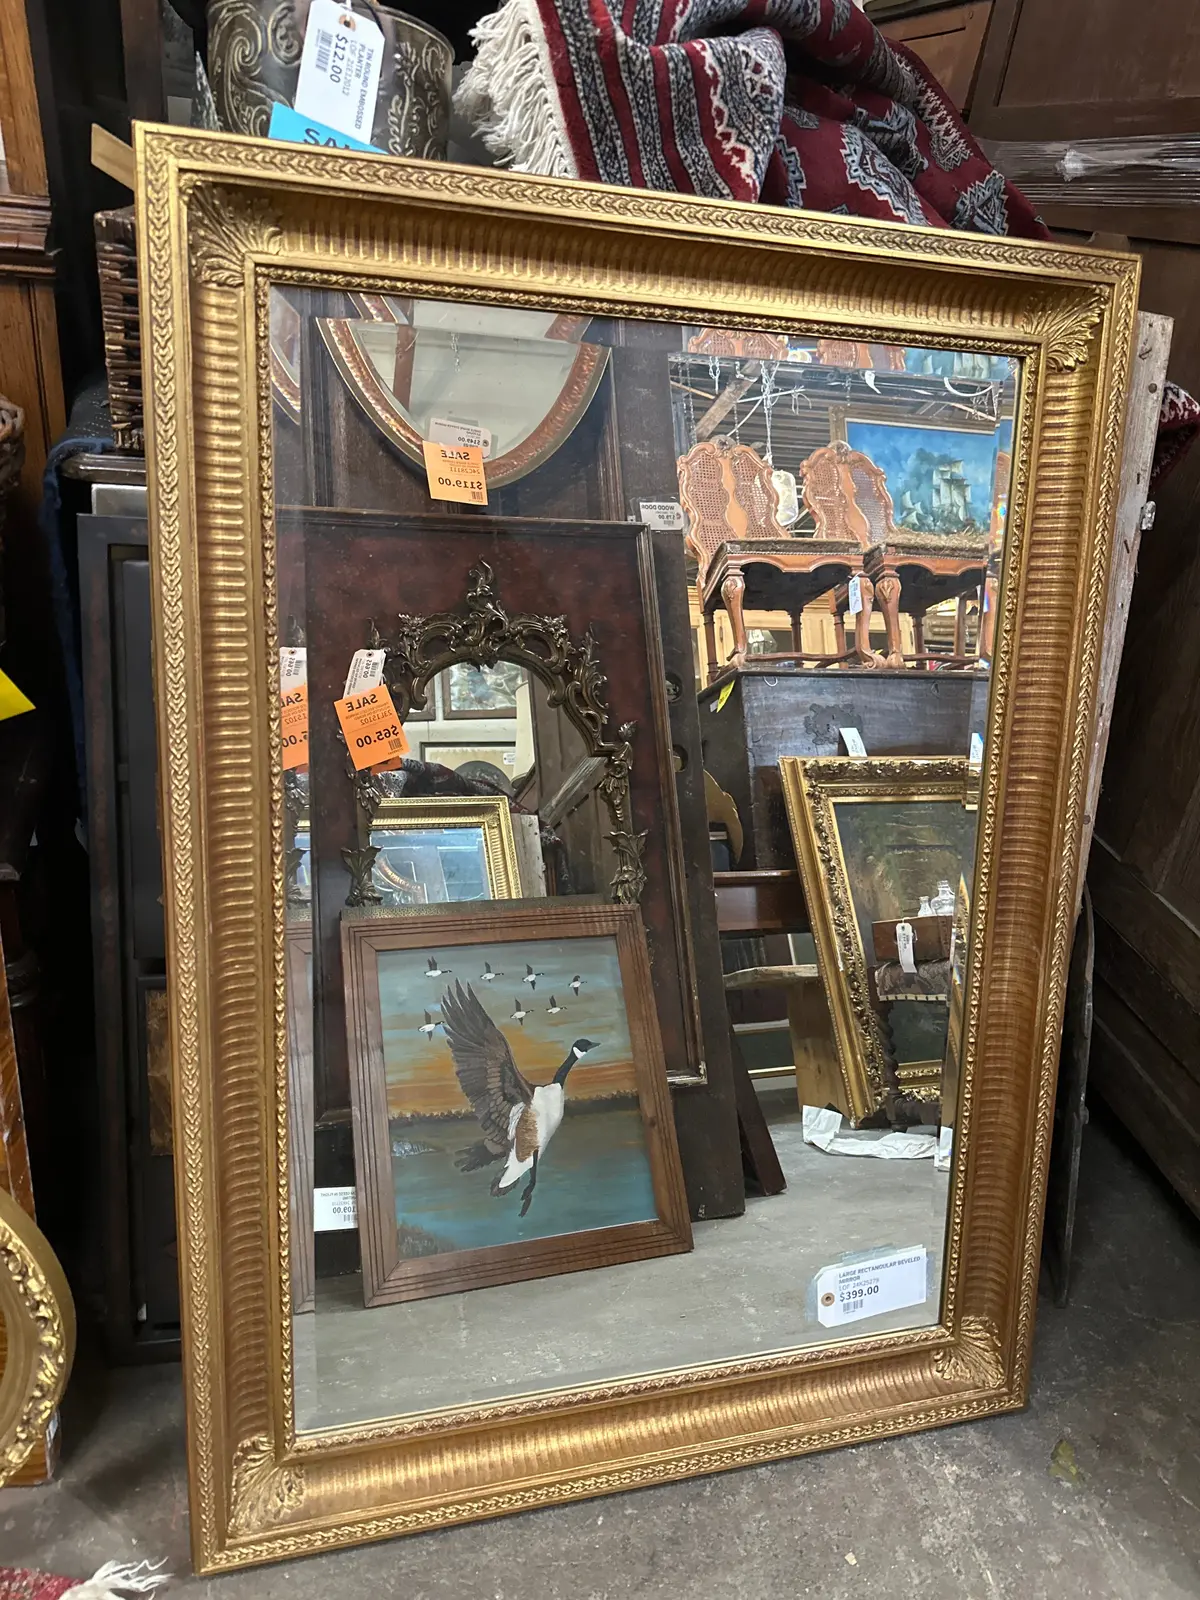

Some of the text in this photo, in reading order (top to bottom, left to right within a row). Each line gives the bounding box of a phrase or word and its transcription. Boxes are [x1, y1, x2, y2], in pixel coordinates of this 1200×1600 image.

[330, 33, 348, 83] $12.00
[354, 43, 366, 79] PLANTER
[355, 48, 374, 130] TIN ROUND EMBOSSED
[839, 1255, 921, 1279] LARGE RECTANGULAR BEVELED
[839, 1276, 860, 1284] MIRROR
[839, 1284, 879, 1303] $399.00
